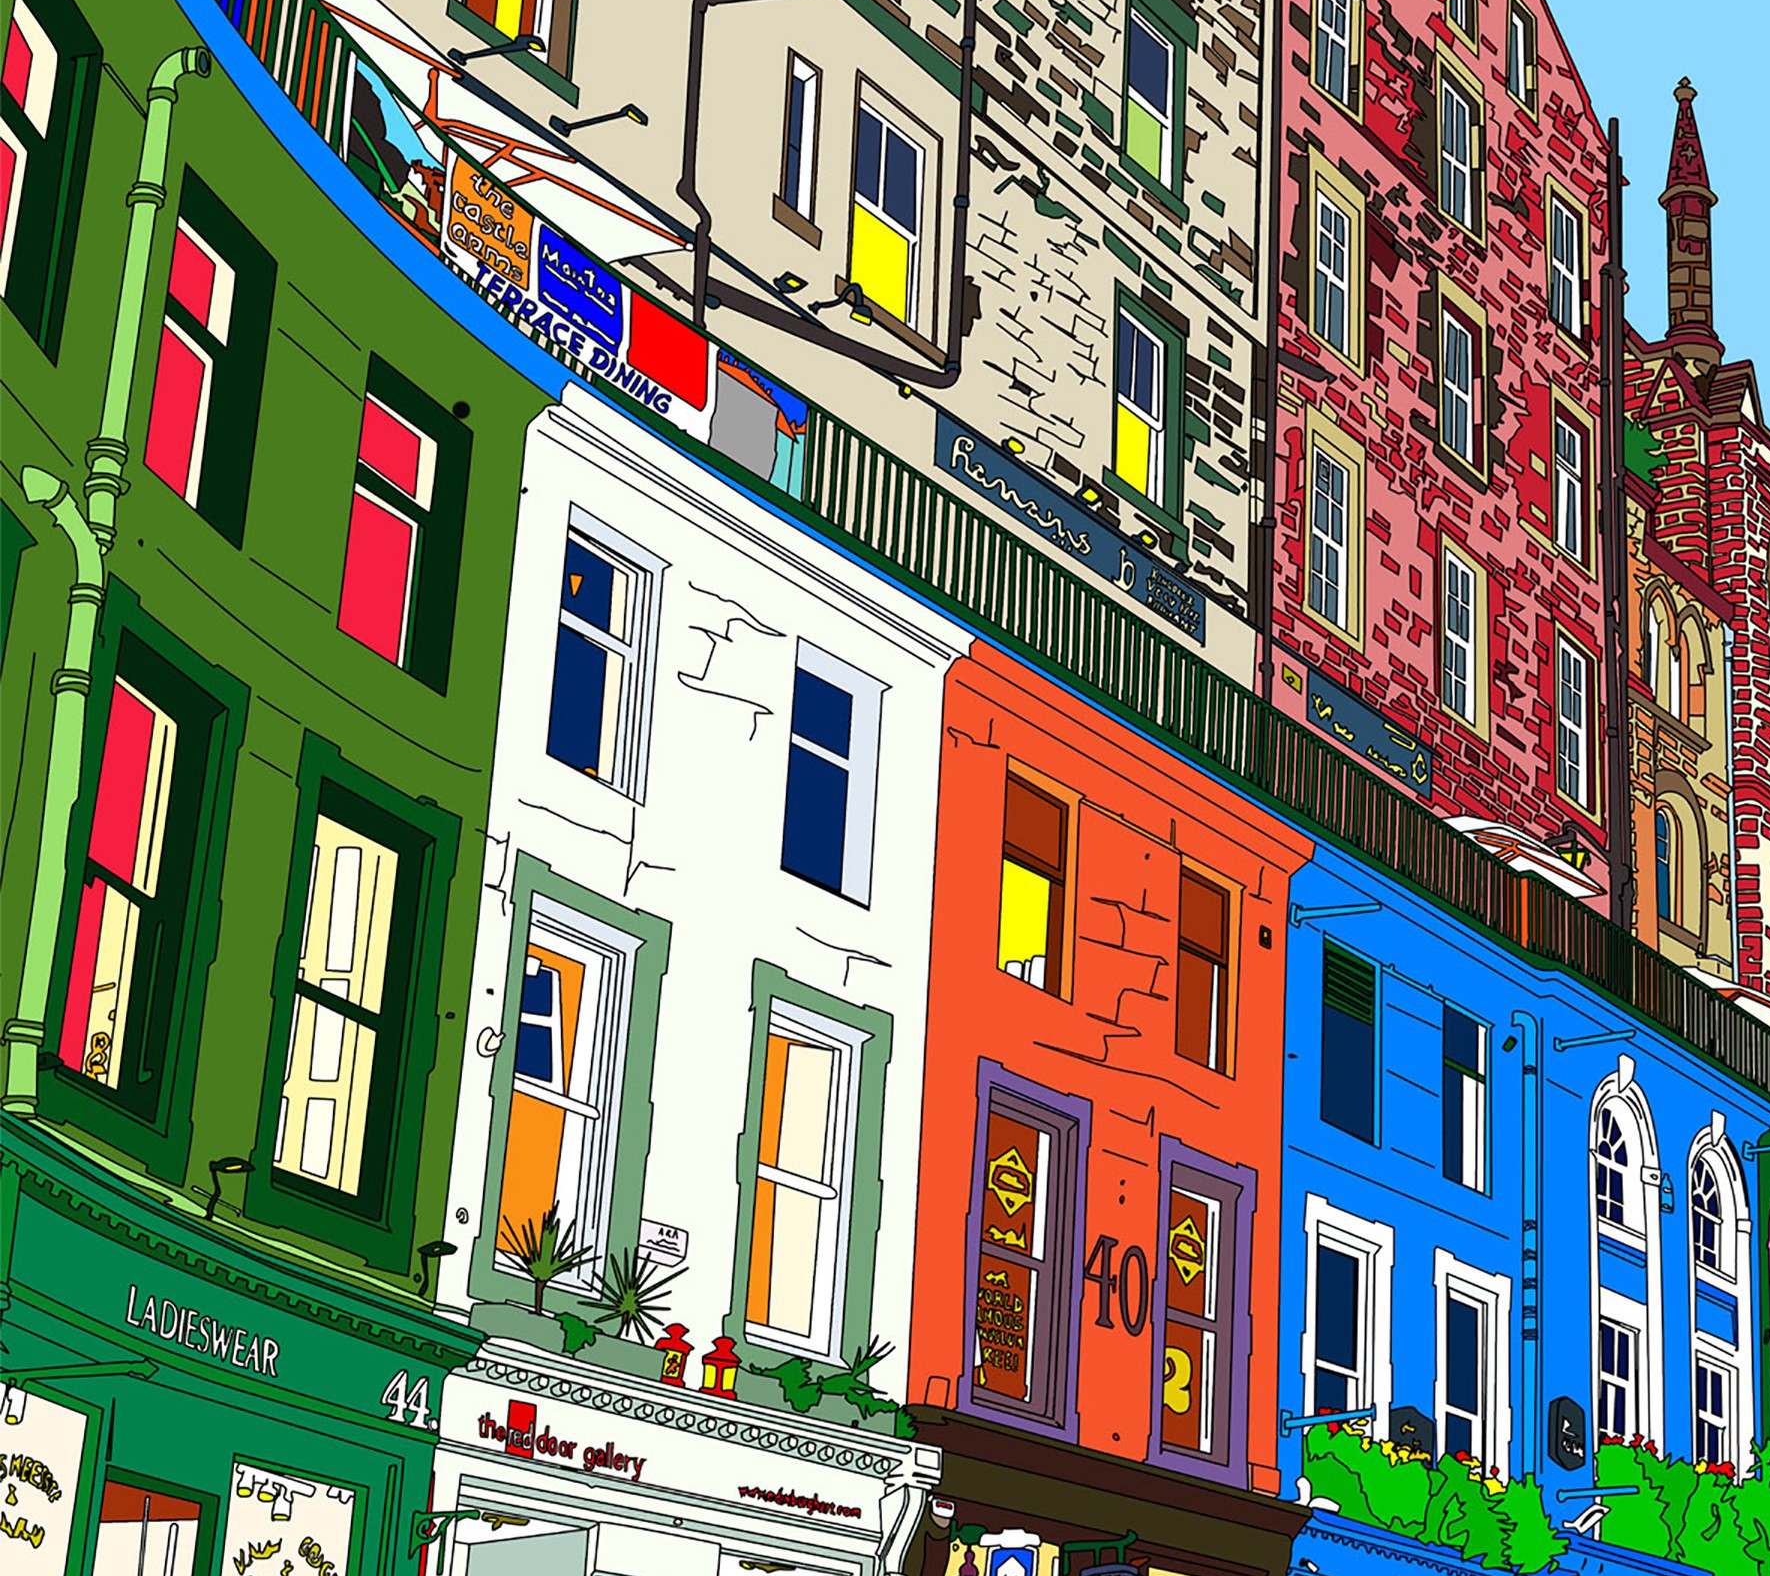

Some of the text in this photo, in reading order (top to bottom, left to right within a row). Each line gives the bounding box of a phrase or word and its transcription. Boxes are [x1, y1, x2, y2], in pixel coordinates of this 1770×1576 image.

[452, 189, 529, 260] castle
[470, 173, 514, 220] the
[475, 260, 587, 356] TERRACE
[589, 345, 673, 415] DINING
[1084, 1234, 1149, 1337] 40
[124, 1284, 281, 1378] LADIESWEAR
[478, 1412, 647, 1482] the red door gallery
